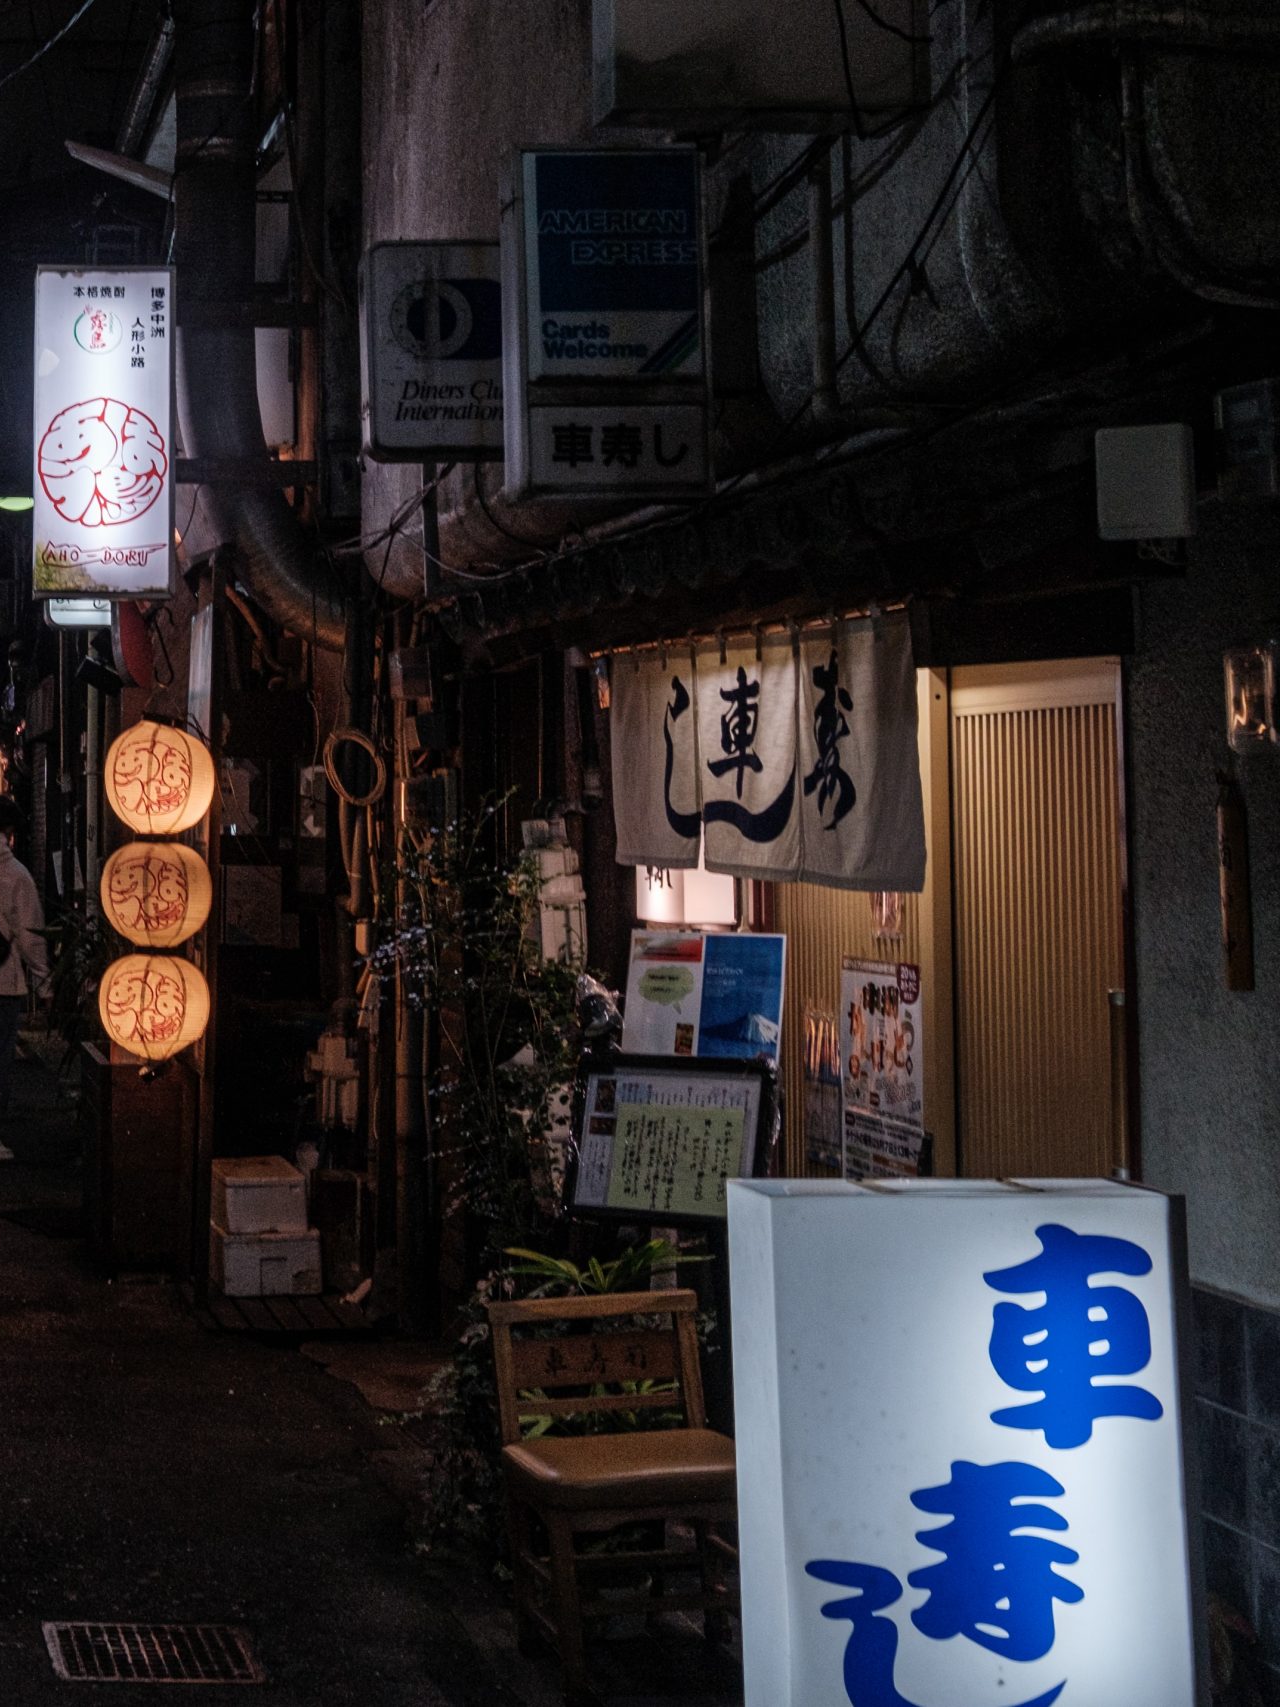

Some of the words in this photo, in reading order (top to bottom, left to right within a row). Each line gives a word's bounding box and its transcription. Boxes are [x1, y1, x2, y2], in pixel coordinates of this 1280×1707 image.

[538, 209, 687, 234] AMERICAN
[571, 240, 698, 265] EXPRESS
[73, 286, 126, 298] 本格焼酎
[151, 287, 166, 338] 博多中洲
[542, 319, 610, 339] Cards
[131, 317, 145, 368] 人形小路
[542, 341, 649, 359] Welcome
[402, 379, 465, 401] Diners
[470, 378, 503, 402] Clu
[395, 402, 504, 421] Internation
[552, 423, 689, 467] 車寿し
